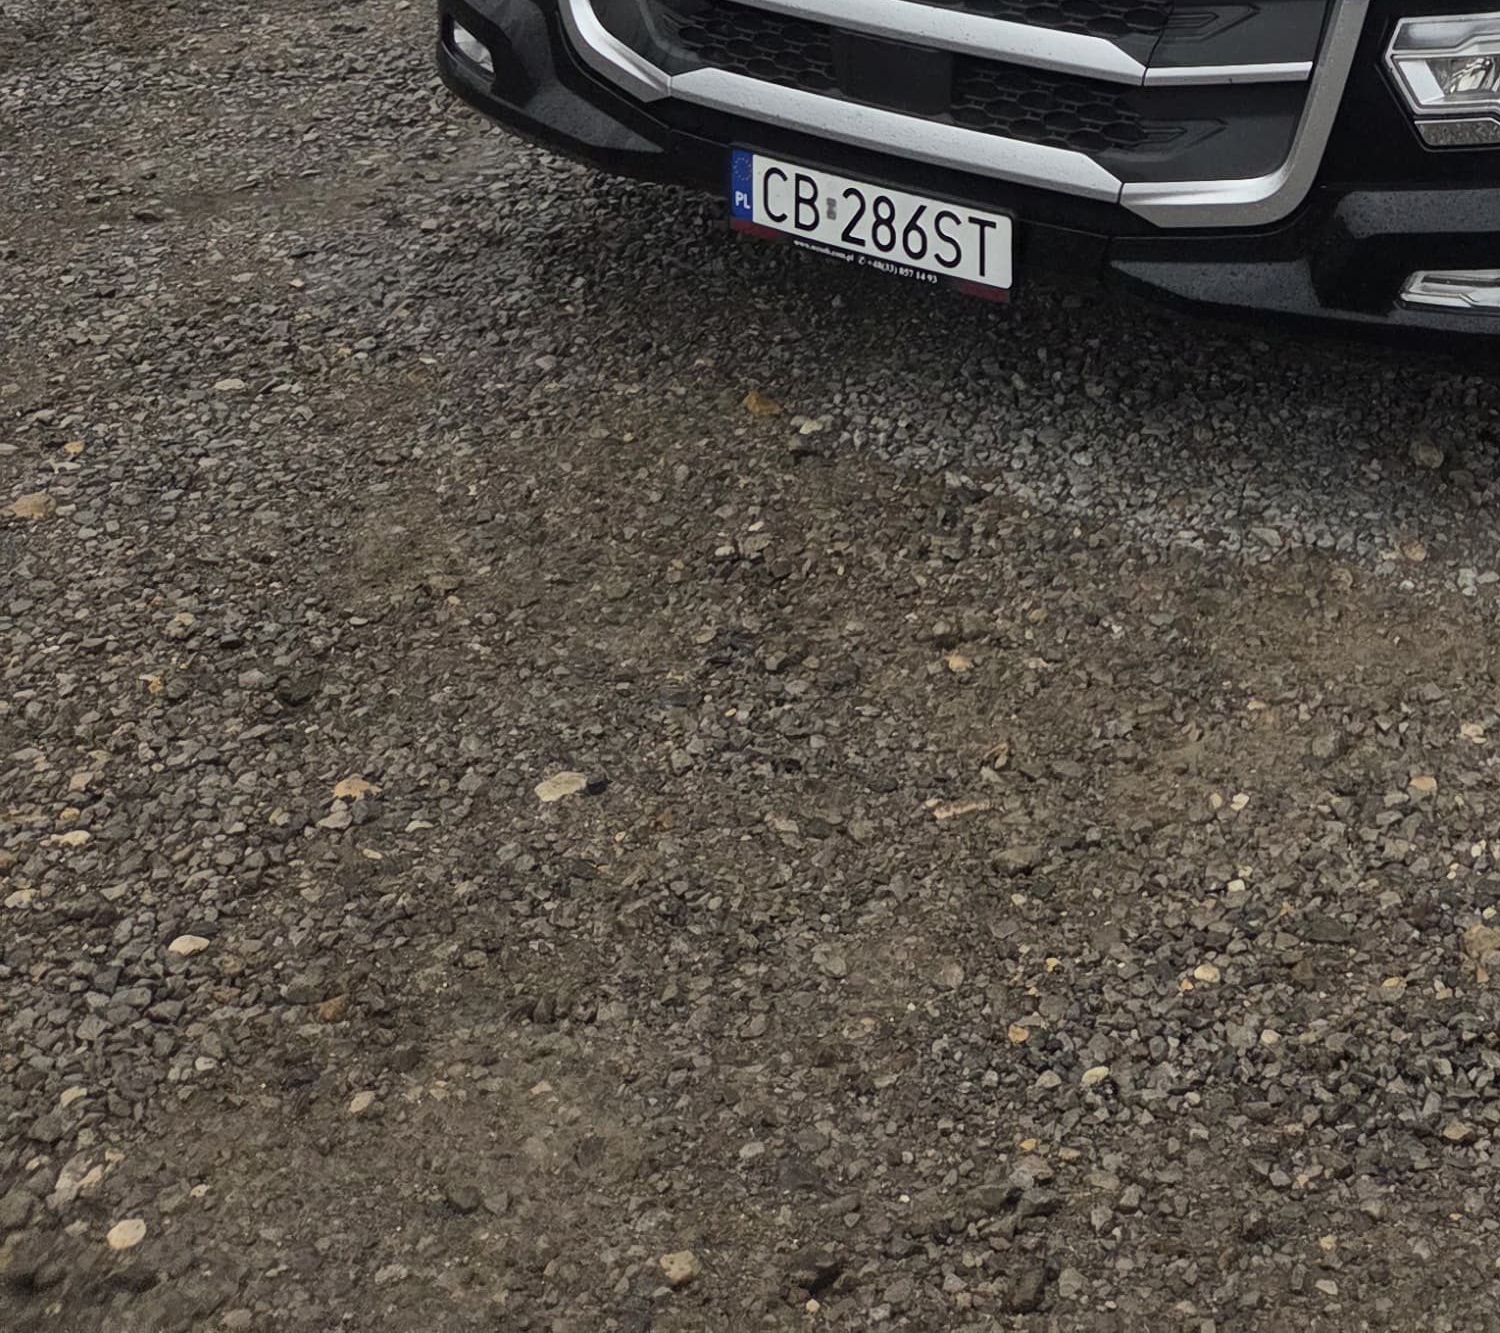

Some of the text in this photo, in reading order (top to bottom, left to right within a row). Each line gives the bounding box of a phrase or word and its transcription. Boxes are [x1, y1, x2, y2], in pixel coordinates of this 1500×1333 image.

[735, 190, 751, 210] PL
[762, 166, 998, 278] CB 286ST
